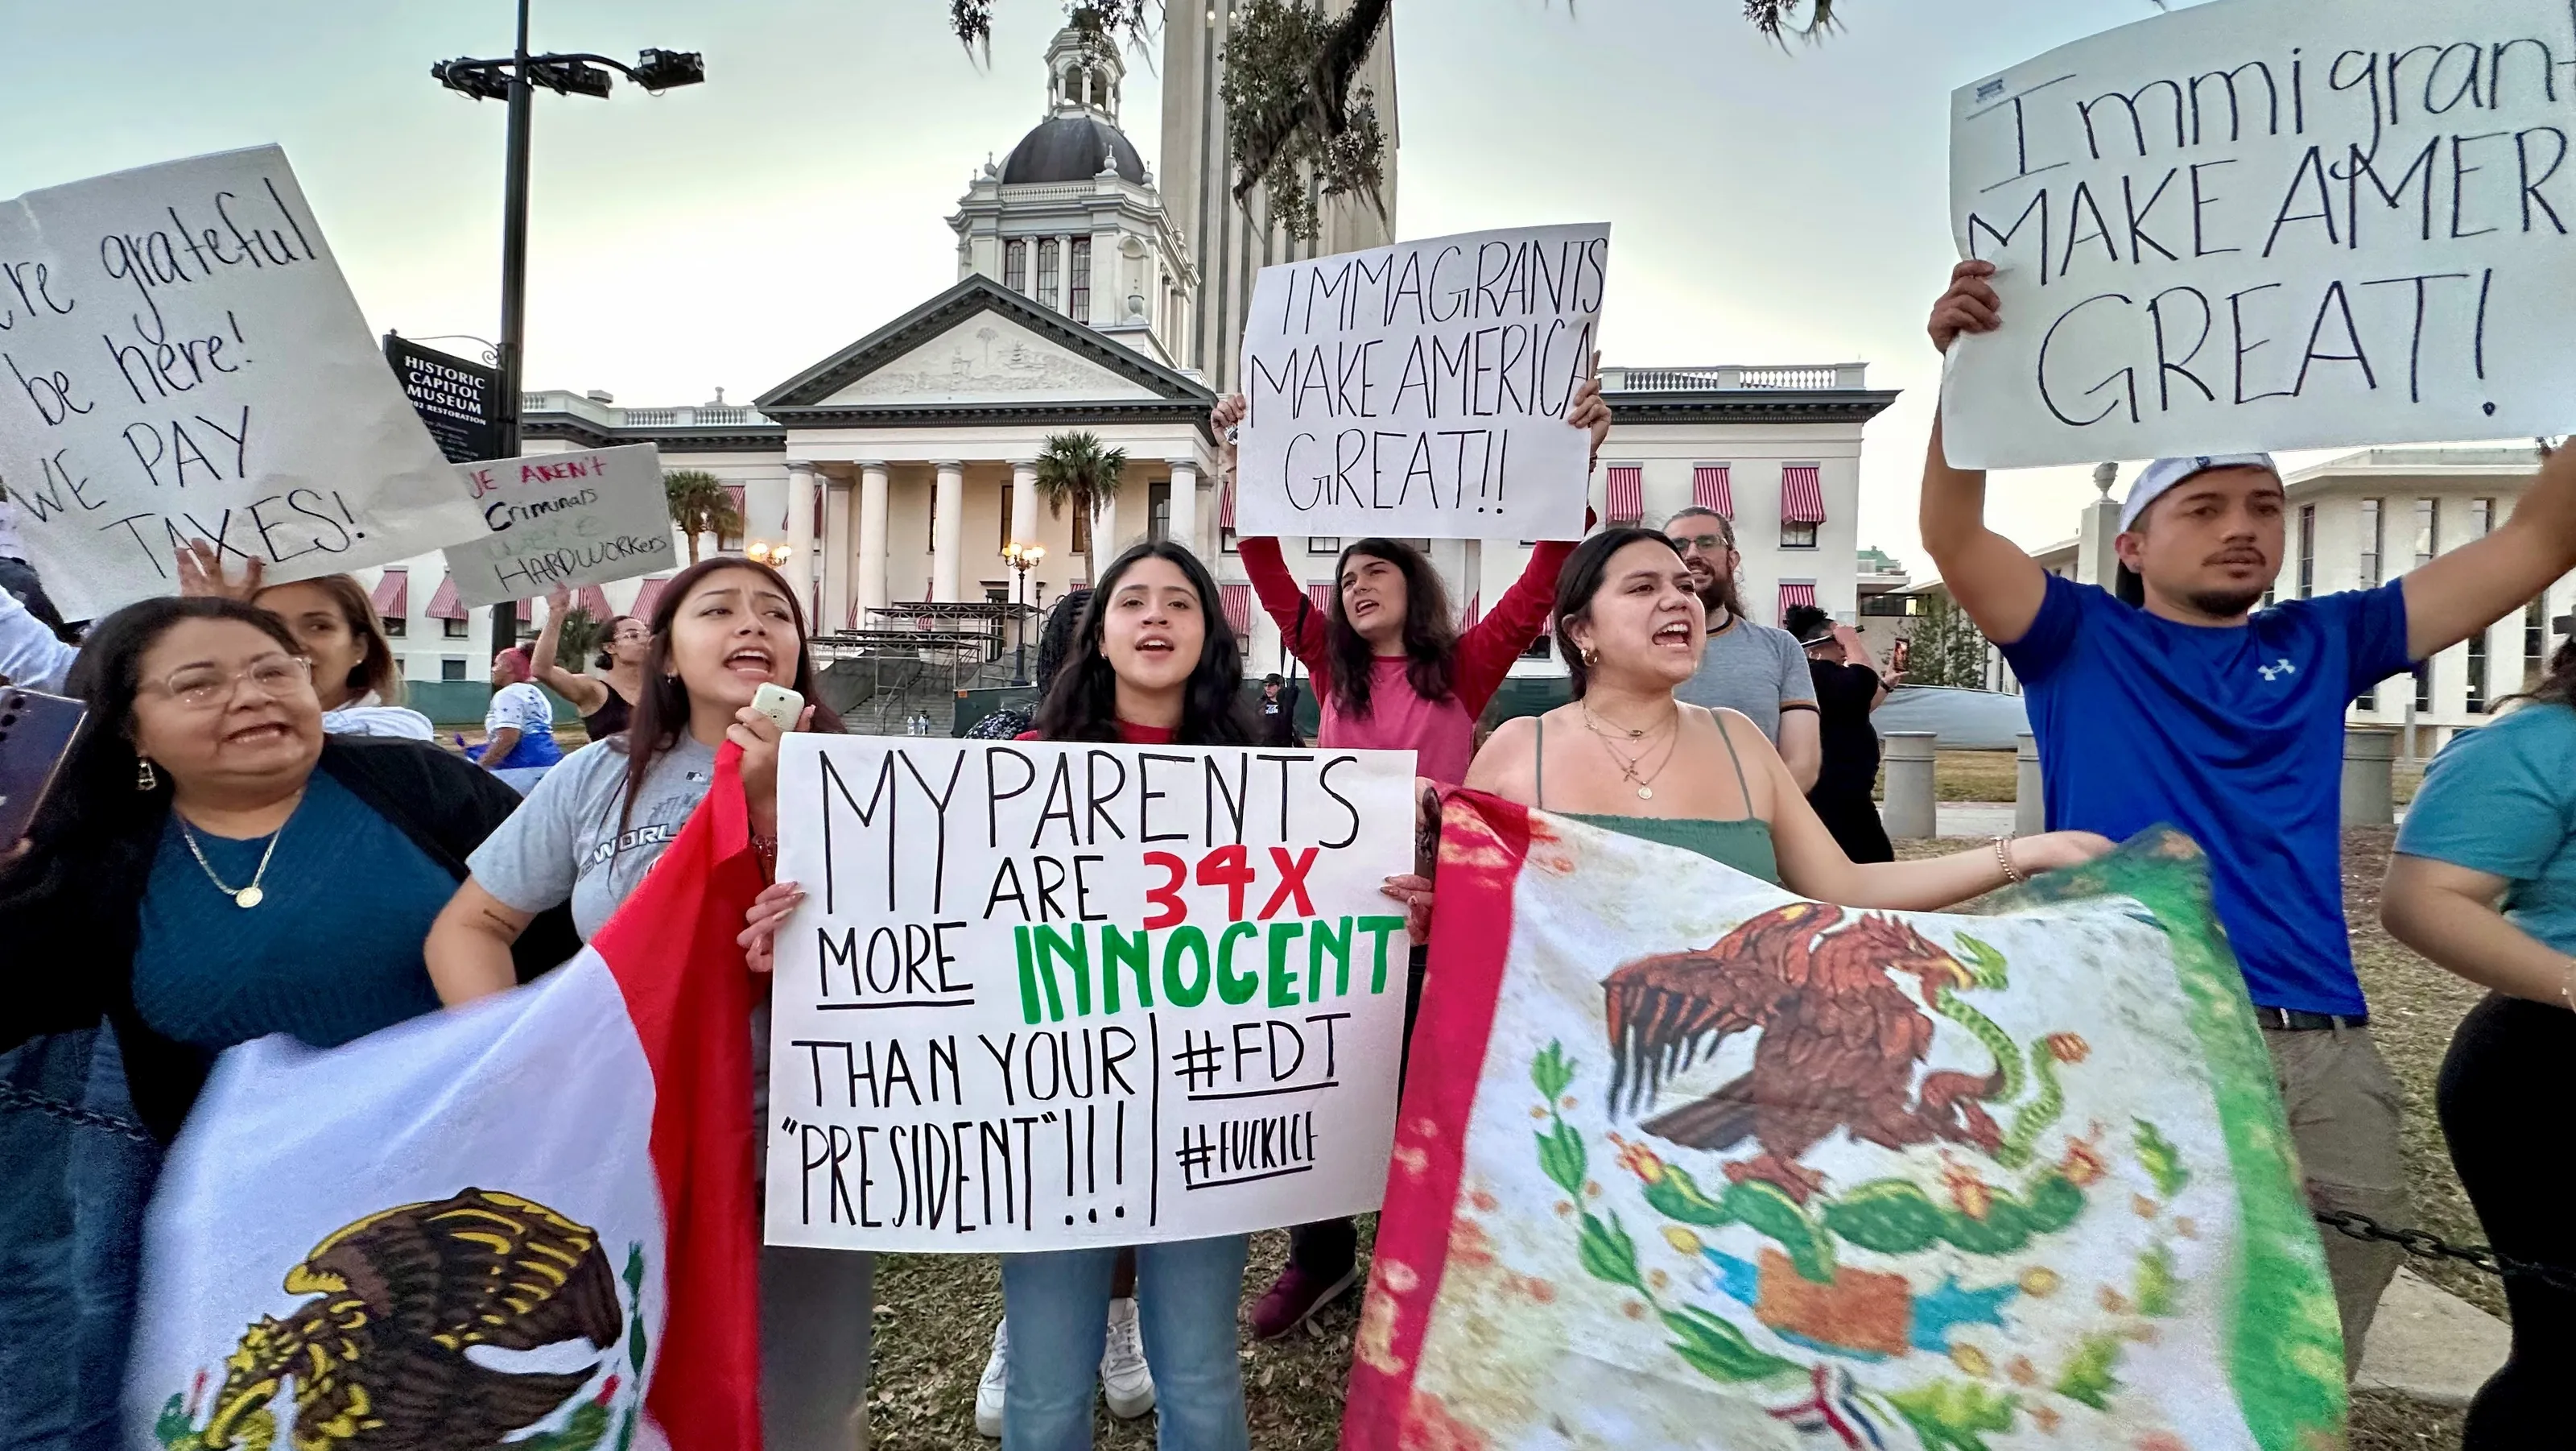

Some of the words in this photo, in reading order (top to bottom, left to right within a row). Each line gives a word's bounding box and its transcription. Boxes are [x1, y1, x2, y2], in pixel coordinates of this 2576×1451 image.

[100, 177, 317, 345] grateful
[1967, 159, 2241, 285] MAKE
[1283, 237, 1608, 335] IMMAGRANTS
[2, 352, 95, 427] be
[102, 310, 254, 404] here!
[404, 355, 485, 390] HISTORIC
[409, 371, 481, 402] CAPITOL
[1250, 339, 1384, 428] MAKE
[1391, 318, 1594, 420] AMERICA
[2037, 267, 2497, 426] GREAT!
[407, 384, 482, 415] MUSEUM
[426, 404, 487, 426] RESTORATION
[4, 448, 107, 523] WE
[122, 405, 250, 488] PAY
[1285, 428, 1509, 515] GREAT!!
[98, 488, 366, 579] TAXES!
[485, 488, 598, 532] Criminals
[592, 822, 687, 865] WORL
[819, 749, 965, 916] MY
[986, 747, 1360, 849] PARENTS
[983, 854, 1108, 923] ARE
[1142, 845, 1320, 930] 34X
[817, 921, 972, 997] MORE
[1013, 916, 1406, 1025] INNOCENT
[791, 1034, 961, 1108] THAN
[977, 1025, 1137, 1106] YOUR
[1172, 1012, 1351, 1093] #FDT
